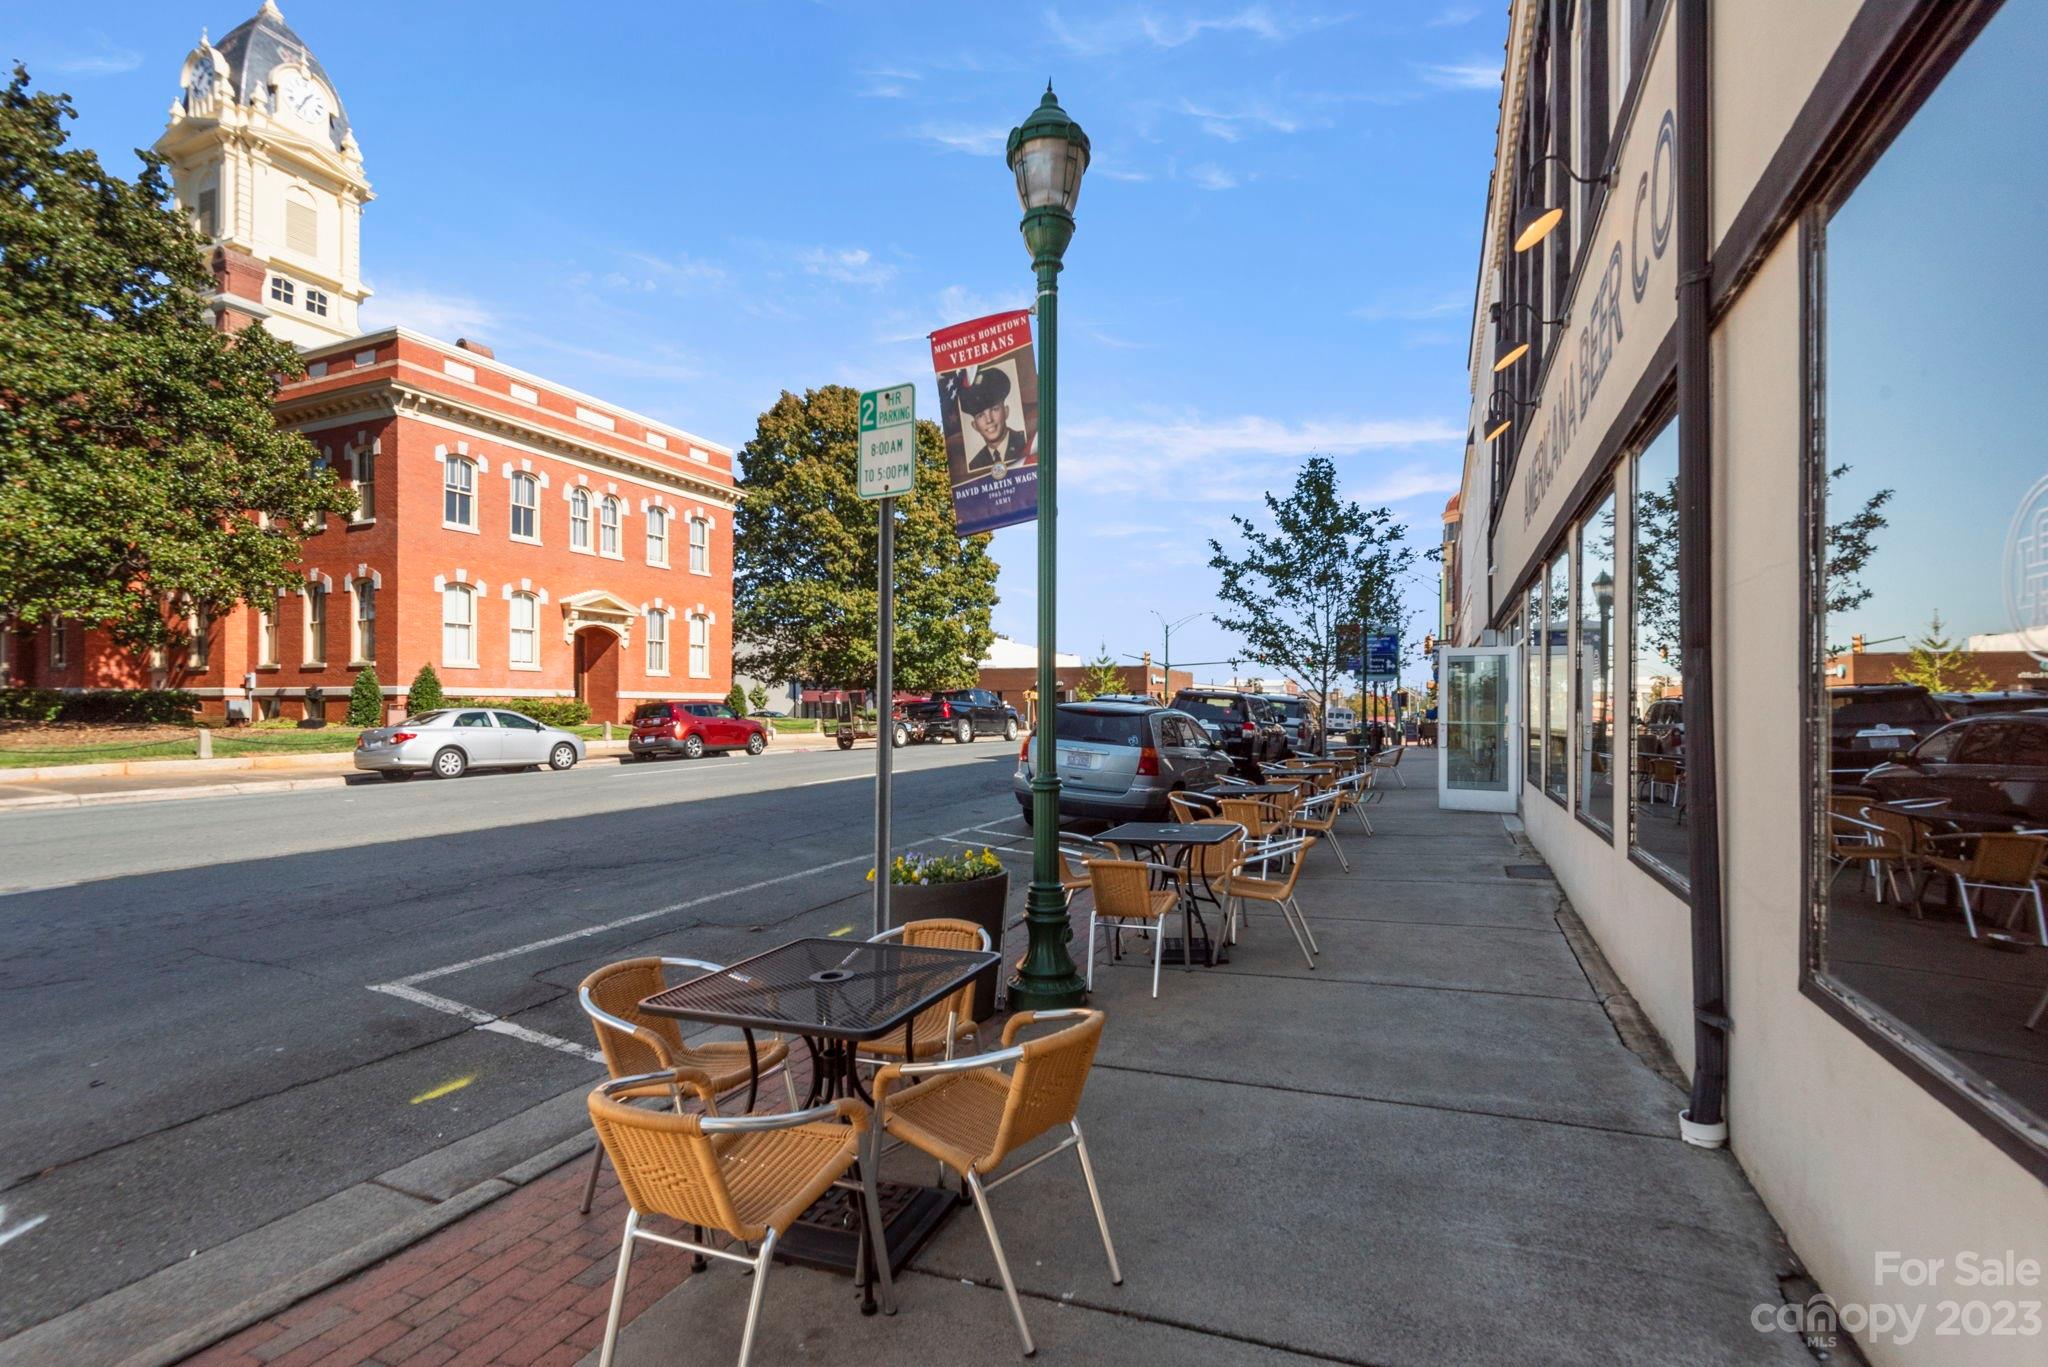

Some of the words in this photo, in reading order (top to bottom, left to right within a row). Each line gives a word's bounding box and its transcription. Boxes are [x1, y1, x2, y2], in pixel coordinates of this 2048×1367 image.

[1524, 361, 1577, 532] AMERICANA
[1580, 240, 1623, 424] BEER
[1632, 109, 1677, 304] CO
[934, 334, 976, 353] MONROE'S
[978, 315, 1027, 340] HOMETOWN
[950, 334, 1014, 364] VETERANS
[887, 392, 901, 406] HR
[862, 399, 875, 427] 2
[879, 406, 910, 424] PARKING
[865, 469, 875, 483] TO
[955, 486, 980, 500] DAVID
[981, 477, 1013, 493] MARTIN
